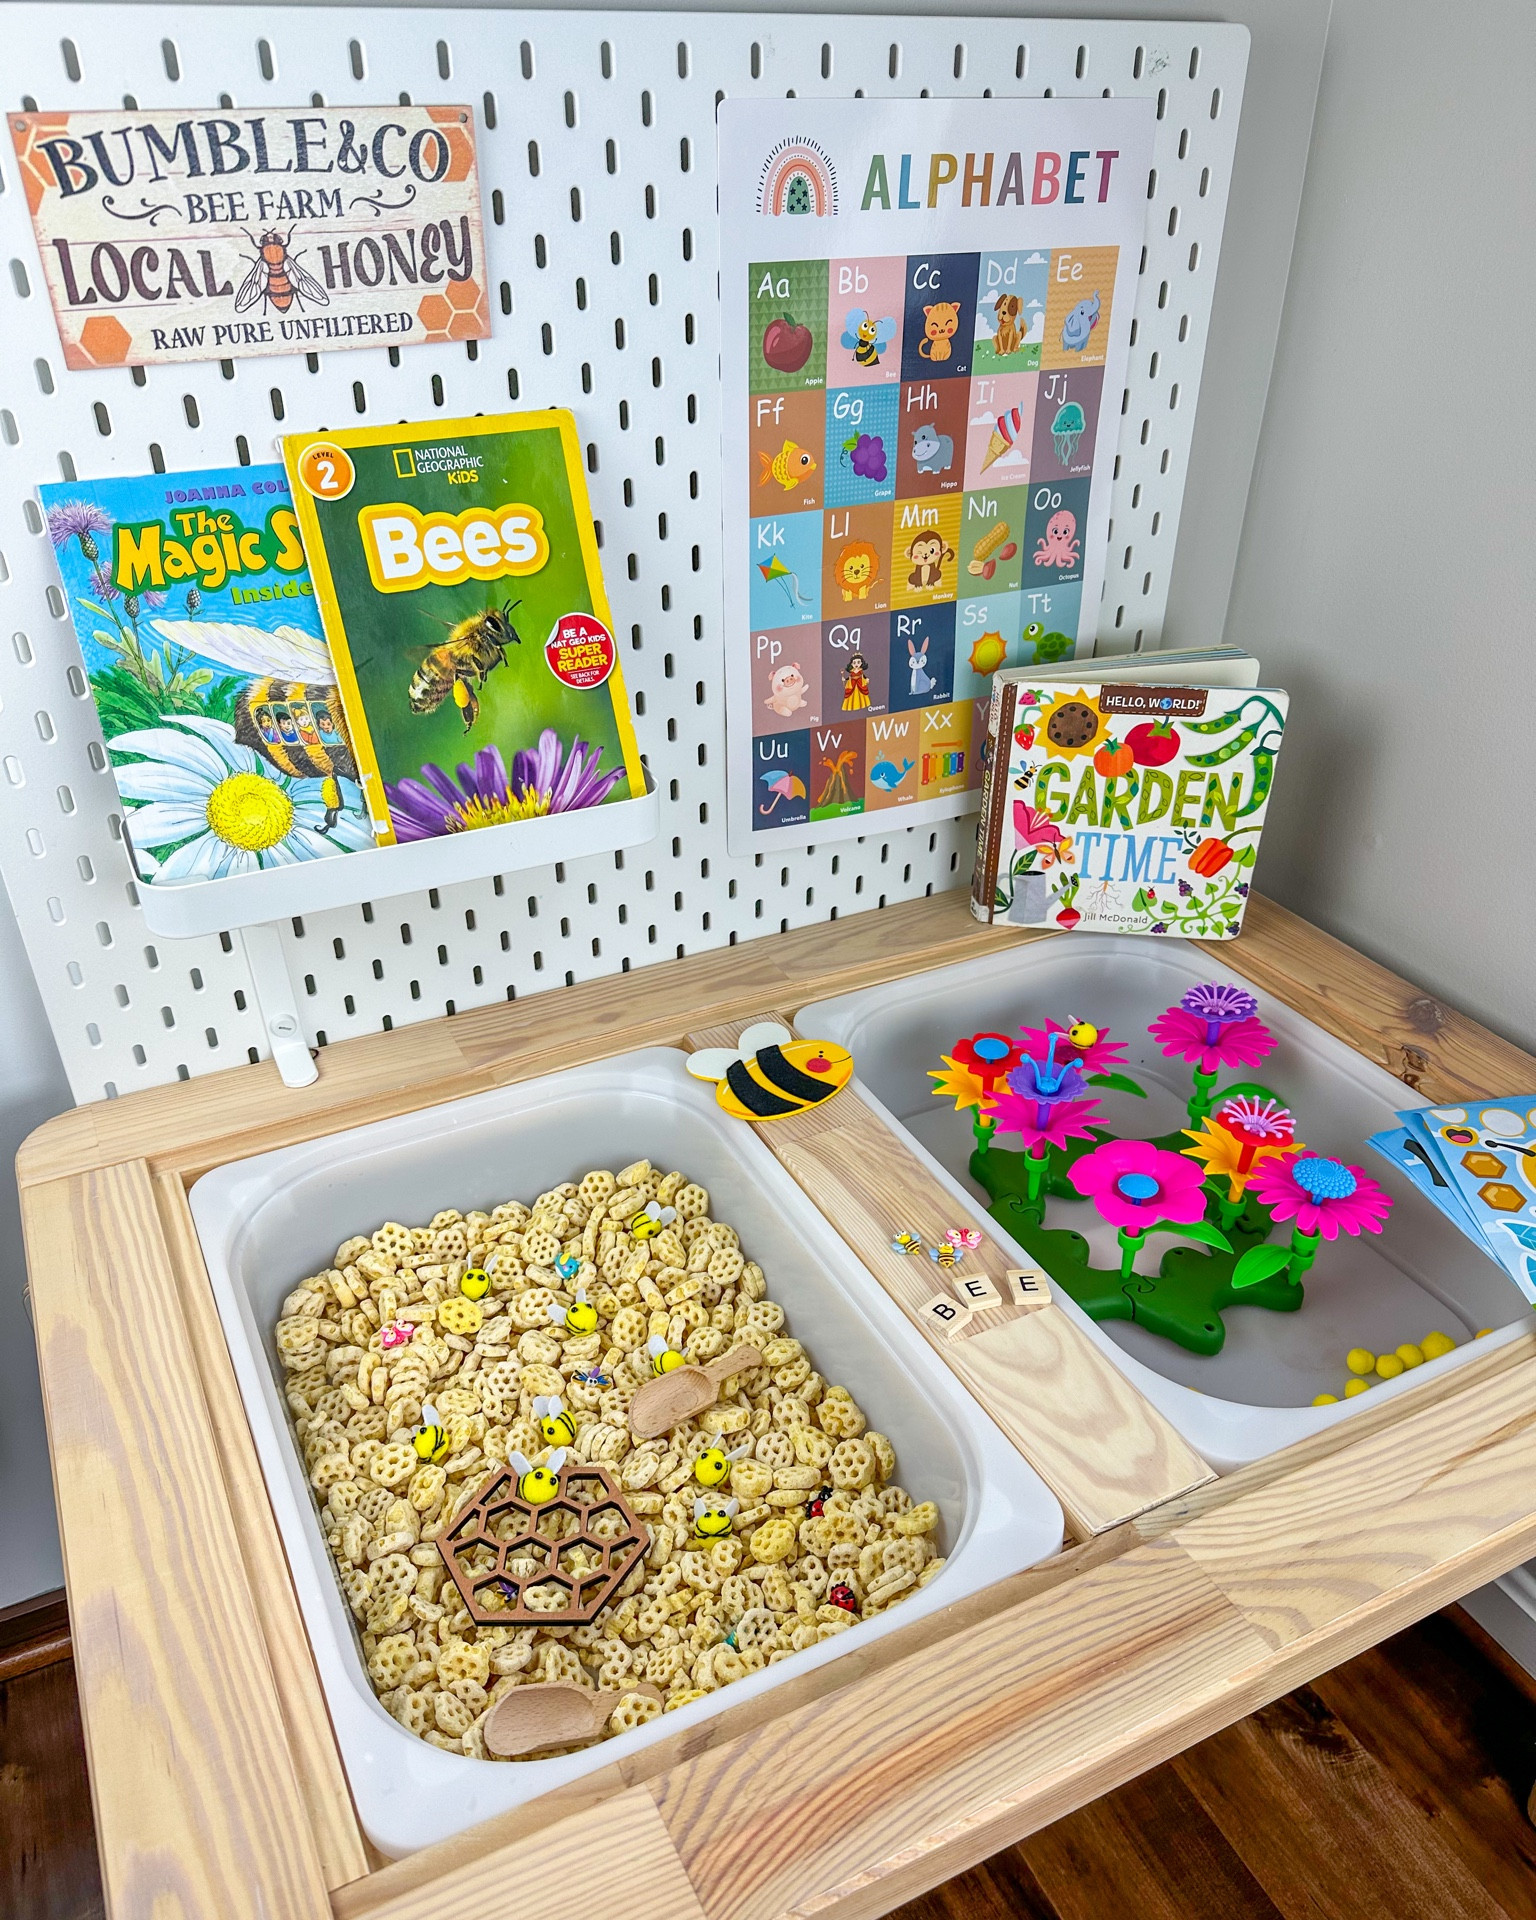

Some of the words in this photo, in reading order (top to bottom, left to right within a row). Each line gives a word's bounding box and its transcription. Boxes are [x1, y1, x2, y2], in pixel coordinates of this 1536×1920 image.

[37, 117, 450, 199] BUMBLE&CO
[860, 150, 1120, 211] ALPHABET
[184, 191, 249, 225] BEE
[257, 187, 346, 221] FARM
[52, 238, 234, 306] LOCAL
[316, 216, 474, 290] HONEY
[986, 257, 1018, 286] Dd
[1056, 254, 1083, 283] Ee
[756, 272, 790, 300] Aa
[838, 266, 869, 294] Bb
[913, 263, 941, 290] Cc
[151, 325, 205, 351] RAW
[213, 320, 274, 345] PURE
[281, 311, 414, 341] UNFILTERED
[1080, 354, 1104, 363] Elephant
[804, 377, 823, 386] Apple
[976, 380, 996, 405] Ii
[1044, 374, 1068, 406] Jj
[833, 392, 864, 425] Gg
[906, 384, 938, 412] Hh
[756, 397, 784, 428] Ff
[312, 452, 334, 460] LEVEL
[414, 445, 468, 461] NATIONAL
[316, 460, 339, 490] 2
[417, 456, 484, 474] GEOGRAPHIC
[1070, 464, 1090, 473] Jellyfish
[165, 483, 247, 505] JOANNA
[874, 489, 892, 498] Grape
[940, 481, 958, 489] Hippo
[804, 498, 816, 506] Fish
[968, 496, 998, 520] Nn
[1034, 488, 1062, 511] Oo
[176, 510, 234, 538] The
[900, 504, 939, 530] Mm
[757, 521, 785, 549] Kk
[114, 523, 267, 591] Magic
[371, 515, 538, 580] Bees
[1058, 573, 1079, 581] Octopus
[231, 580, 313, 605] Inside
[932, 592, 954, 600] Monkey
[1027, 593, 1052, 614] Tt
[896, 615, 922, 637] Rr
[962, 604, 988, 626] Ss
[551, 640, 567, 649] NAT
[569, 637, 586, 646] GEO
[587, 634, 606, 643] KIDS
[562, 628, 577, 639] BE
[580, 627, 588, 637] A
[828, 624, 862, 651] Qq
[559, 643, 602, 660] SUPER
[756, 636, 782, 664] Pp
[557, 654, 608, 672] READER
[933, 692, 950, 700] Rabbit
[1106, 695, 1146, 709] HELLO,
[872, 718, 909, 741] Ww
[924, 710, 953, 732] Xx
[760, 739, 788, 761] Uu
[816, 729, 842, 751] Vv
[980, 769, 991, 826] GARDEN
[1034, 761, 1243, 831] GARDEN
[782, 815, 806, 823] Umbrella
[840, 805, 861, 813] Volcano
[977, 826, 985, 860] TIME
[1074, 831, 1184, 885] TIME
[1083, 913, 1096, 922] Jill
[1100, 914, 1148, 924] McDonald
